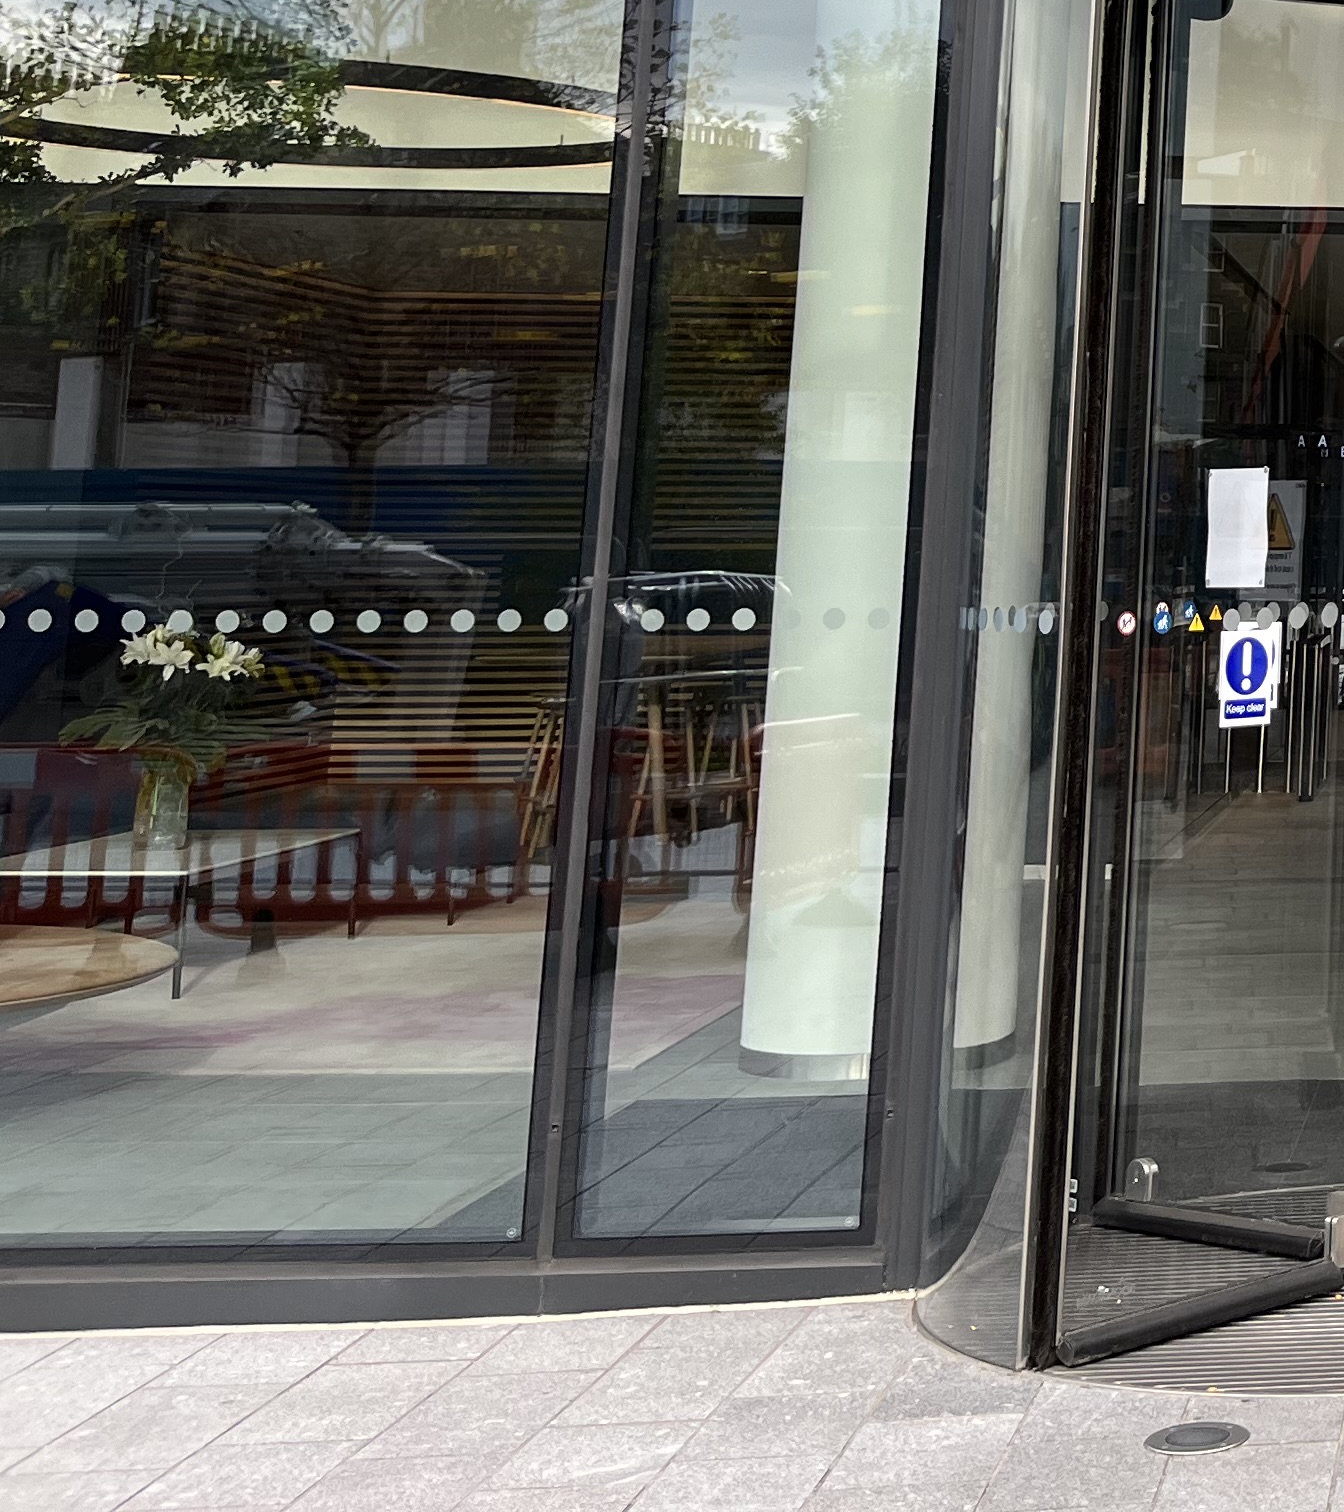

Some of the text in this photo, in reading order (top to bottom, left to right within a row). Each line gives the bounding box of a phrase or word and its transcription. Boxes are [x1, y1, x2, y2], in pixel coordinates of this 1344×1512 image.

[1317, 434, 1328, 448] A
[1226, 702, 1265, 715] Keep clear
